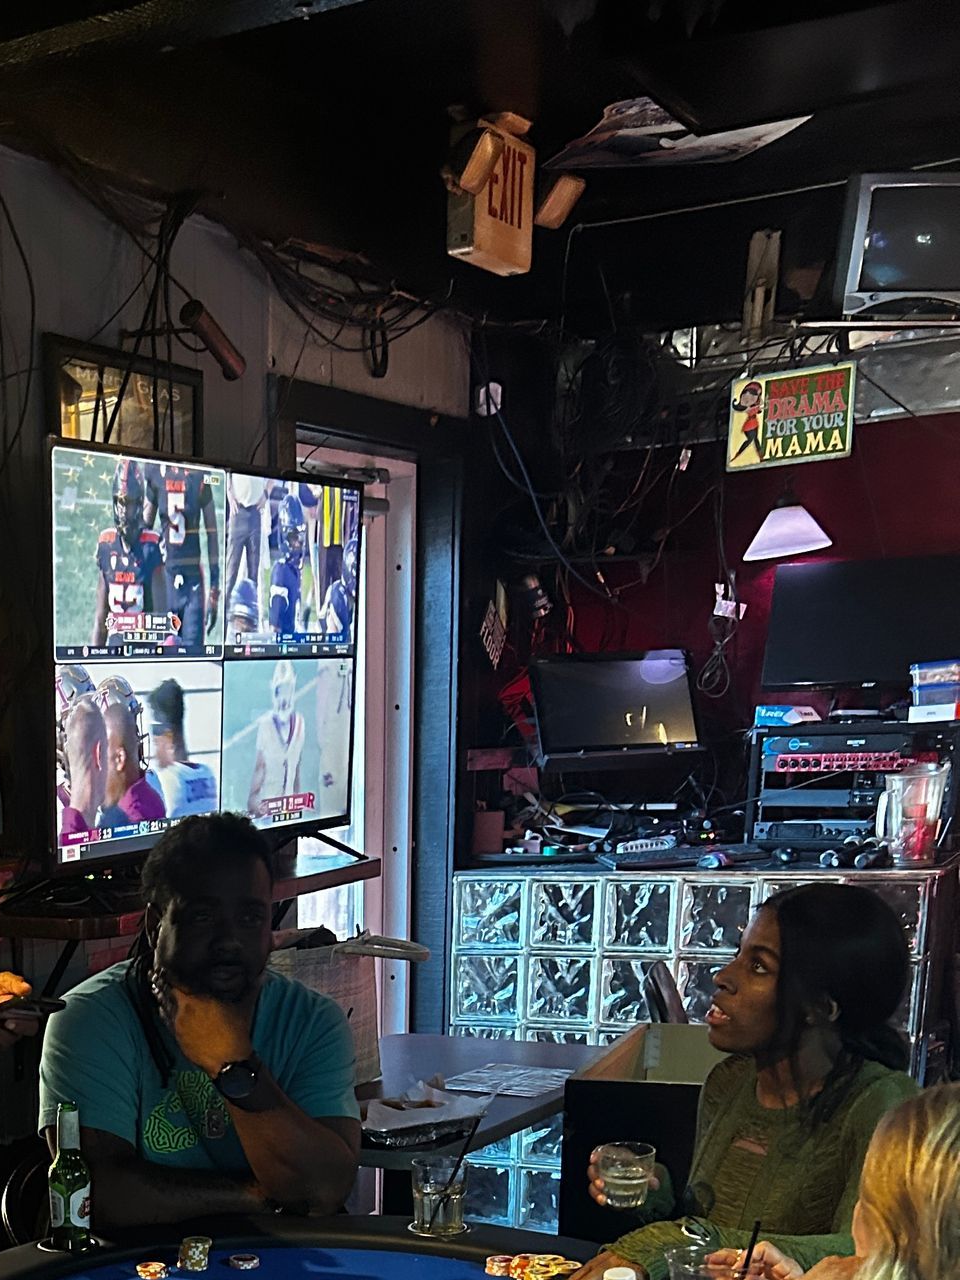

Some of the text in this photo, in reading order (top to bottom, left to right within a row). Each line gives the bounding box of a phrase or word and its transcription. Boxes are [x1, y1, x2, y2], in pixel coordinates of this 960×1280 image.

[770, 372, 846, 397] SAVE THE
[767, 390, 847, 421] DRAMA
[766, 412, 845, 438] FOR YOUR
[762, 428, 844, 460] MAMA
